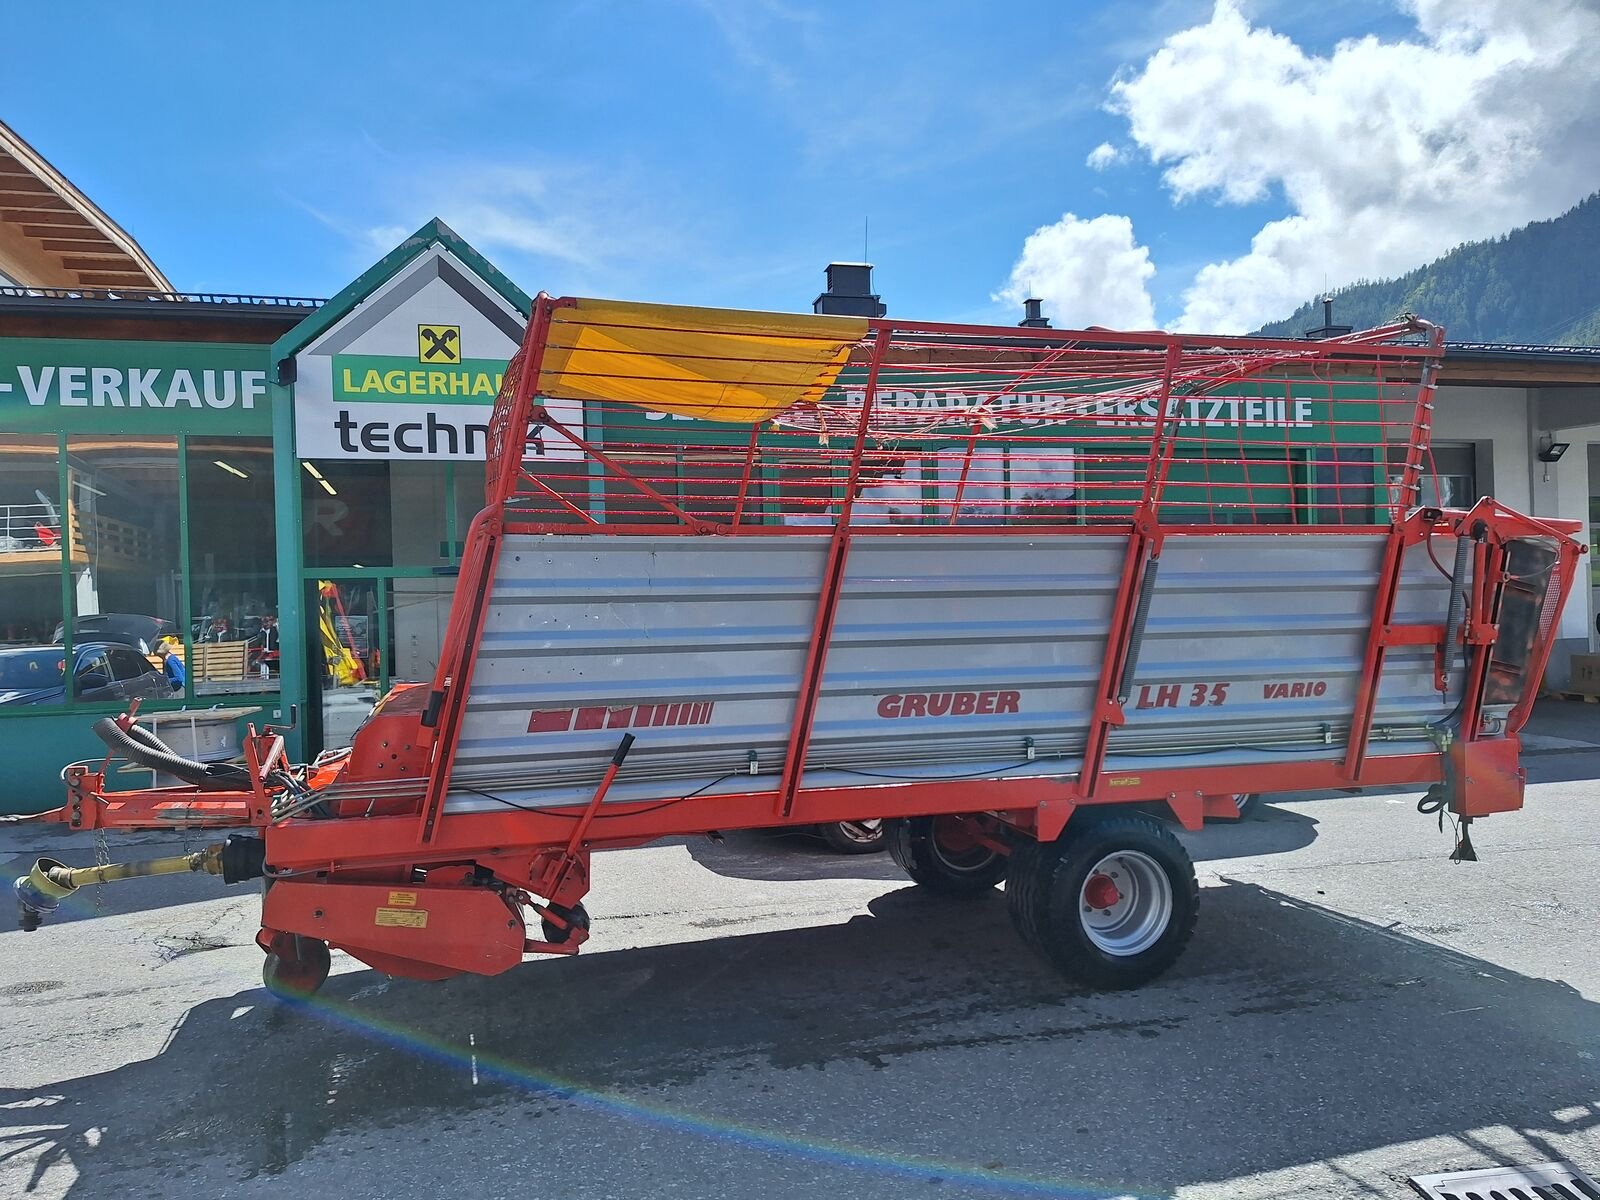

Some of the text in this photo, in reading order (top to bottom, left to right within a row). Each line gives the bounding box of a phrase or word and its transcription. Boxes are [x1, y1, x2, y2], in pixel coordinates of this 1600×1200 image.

[334, 410, 546, 456] technk
[877, 690, 1021, 719] GRUBER
[1135, 681, 1328, 709] LH 35 VARIO
